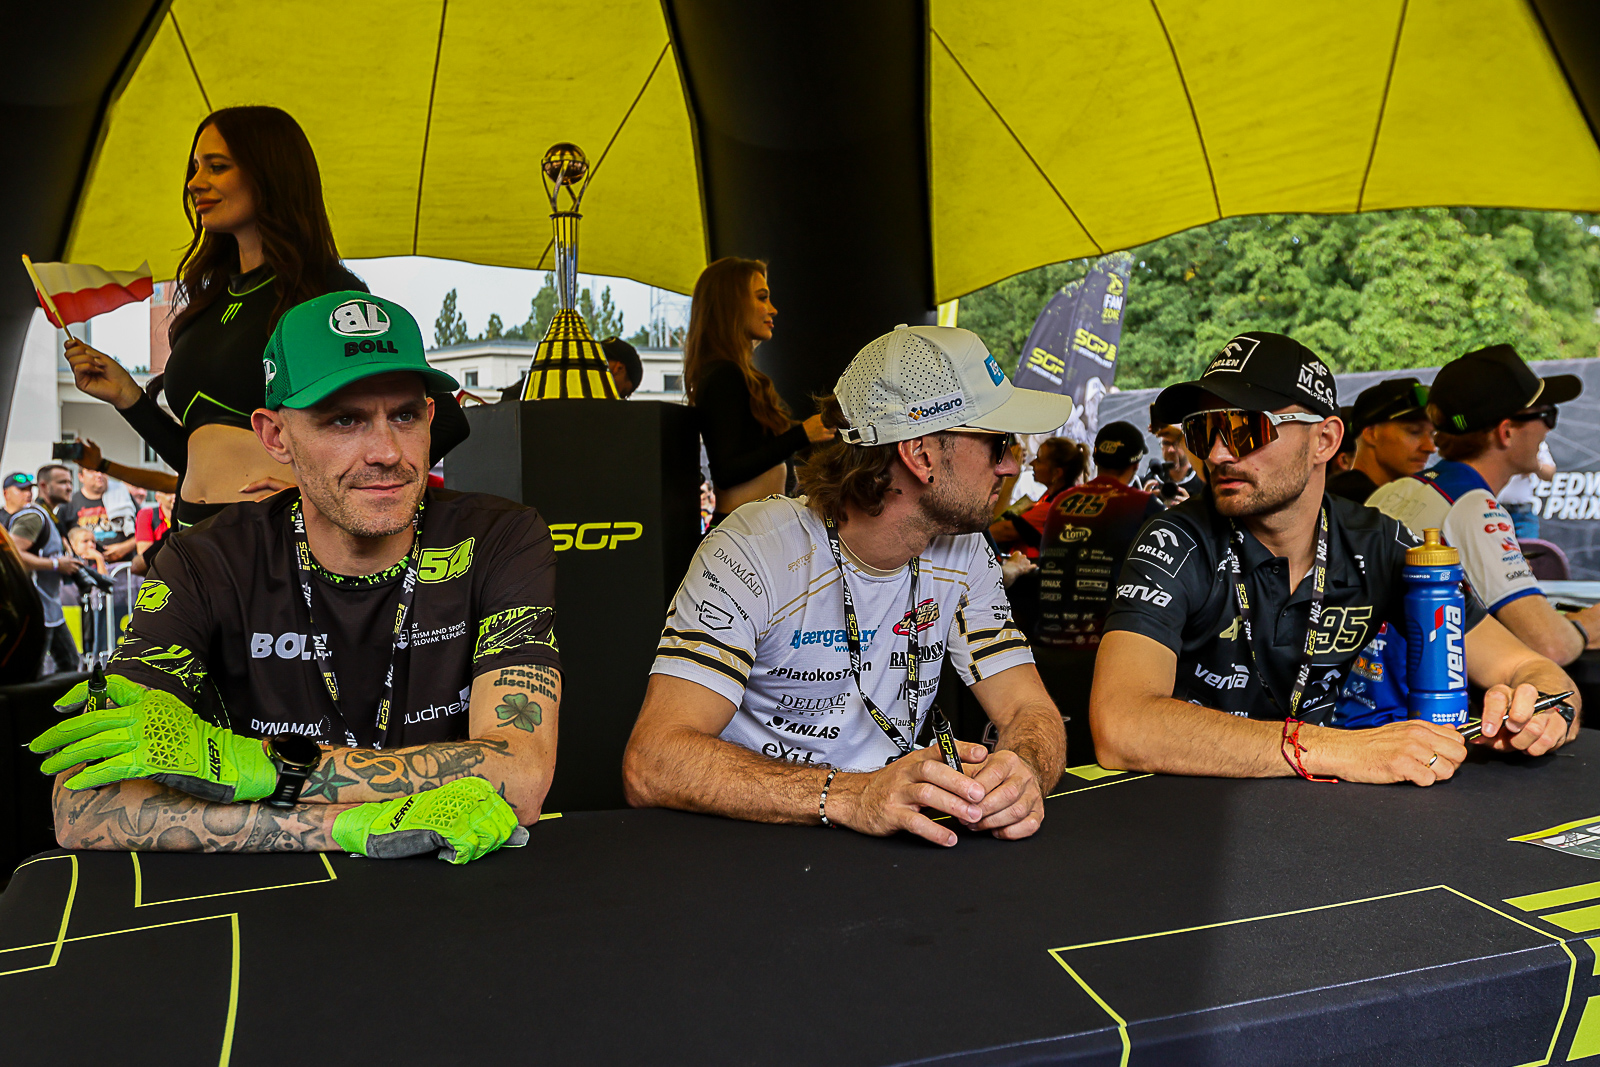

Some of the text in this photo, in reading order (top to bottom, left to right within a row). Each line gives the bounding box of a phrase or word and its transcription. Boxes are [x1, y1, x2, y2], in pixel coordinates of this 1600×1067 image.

[1103, 294, 1123, 310] FAN
[344, 340, 398, 357] BOLL
[1073, 328, 1109, 354] SGP
[921, 397, 963, 418] bokaro
[1057, 493, 1107, 517] 415
[294, 512, 305, 534] FIM
[548, 521, 643, 552] SGP
[417, 537, 475, 584] 54
[1137, 544, 1175, 565] ORLEN
[1316, 541, 1327, 562] FIM
[713, 547, 764, 598] DANMIND
[1231, 554, 1241, 574] FIM
[403, 566, 419, 590] FIM
[844, 586, 853, 606] FIM
[1309, 603, 1322, 624] FIM
[413, 635, 440, 646] SLOVAK
[431, 627, 447, 636] AND
[909, 620, 918, 641] FIM
[1244, 621, 1253, 641] FIM
[1314, 606, 1374, 655] 95
[312, 635, 327, 657] FIM
[1444, 604, 1465, 690] verva
[851, 652, 861, 673] FIM
[908, 658, 916, 682] SGP
[500, 669, 556, 688] practice
[1297, 666, 1310, 687] FIM
[325, 677, 338, 701] SGP
[493, 677, 558, 702] discipline
[908, 689, 917, 707] FIM
[779, 692, 846, 710] DELUXE
[380, 699, 390, 726] SGP
[873, 711, 892, 731] SGP
[251, 718, 322, 737] DYNAMAX
[784, 722, 841, 740] ANLAS
[939, 733, 953, 755] SGP
[207, 737, 221, 782] LEATT
[389, 796, 415, 830] LEATT
